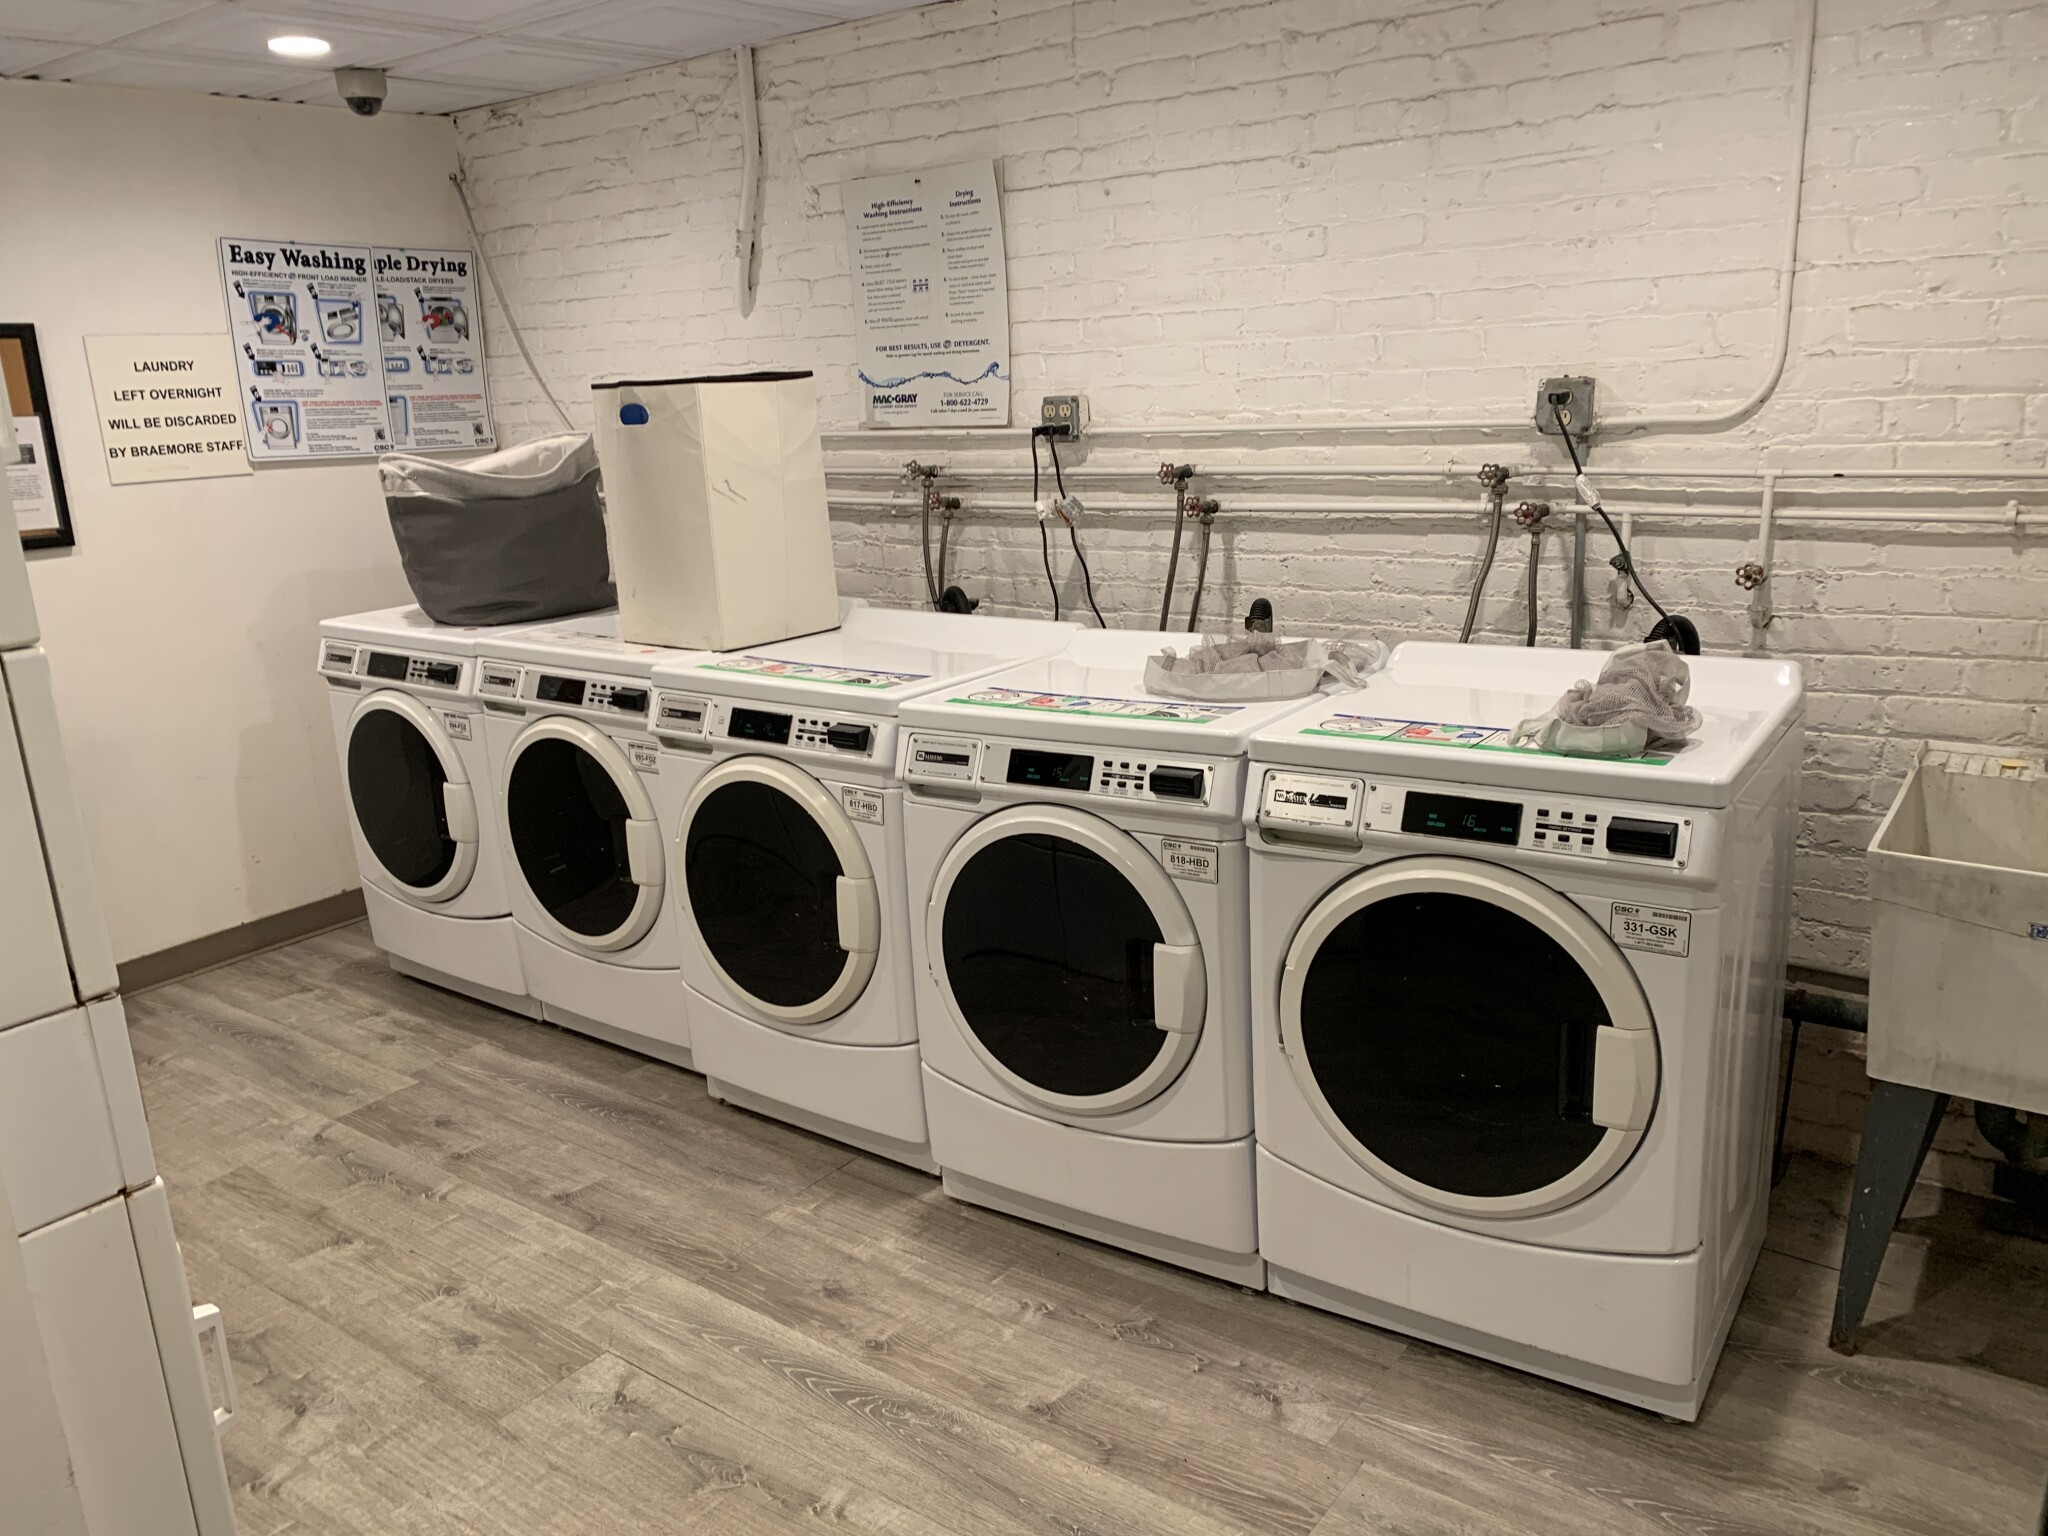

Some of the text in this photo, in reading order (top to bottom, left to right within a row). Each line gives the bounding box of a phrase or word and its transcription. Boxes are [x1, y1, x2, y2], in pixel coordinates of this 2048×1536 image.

[956, 190, 974, 198] Drying
[871, 199, 913, 210] High-Efficiency
[949, 198, 981, 207] Instructions
[889, 206, 922, 215] Instructions
[229, 244, 367, 275] Easy Washing
[374, 254, 467, 277] ple Drying
[231, 270, 288, 279] HIGH-EFFICIENCY
[298, 273, 319, 281] FRONT
[340, 275, 367, 283] WASHER
[428, 277, 455, 285] DRYERS
[904, 343, 929, 351] RESULTS,
[954, 339, 990, 348] DETERGENT.
[134, 360, 194, 372] LAUNDRY
[114, 387, 222, 401] LEFT OVERNIGHT
[940, 398, 989, 407] 1-800-622-4729
[108, 414, 237, 430] WILL BE DISCARDED
[109, 440, 246, 458] BY BRAEMORE STAFF.
[849, 800, 878, 812] 817-HBD
[1462, 814, 1477, 828] 16
[1170, 854, 1210, 868] 818-HBD
[1614, 905, 1634, 913] CSC
[1623, 921, 1678, 938] 331-GSK
